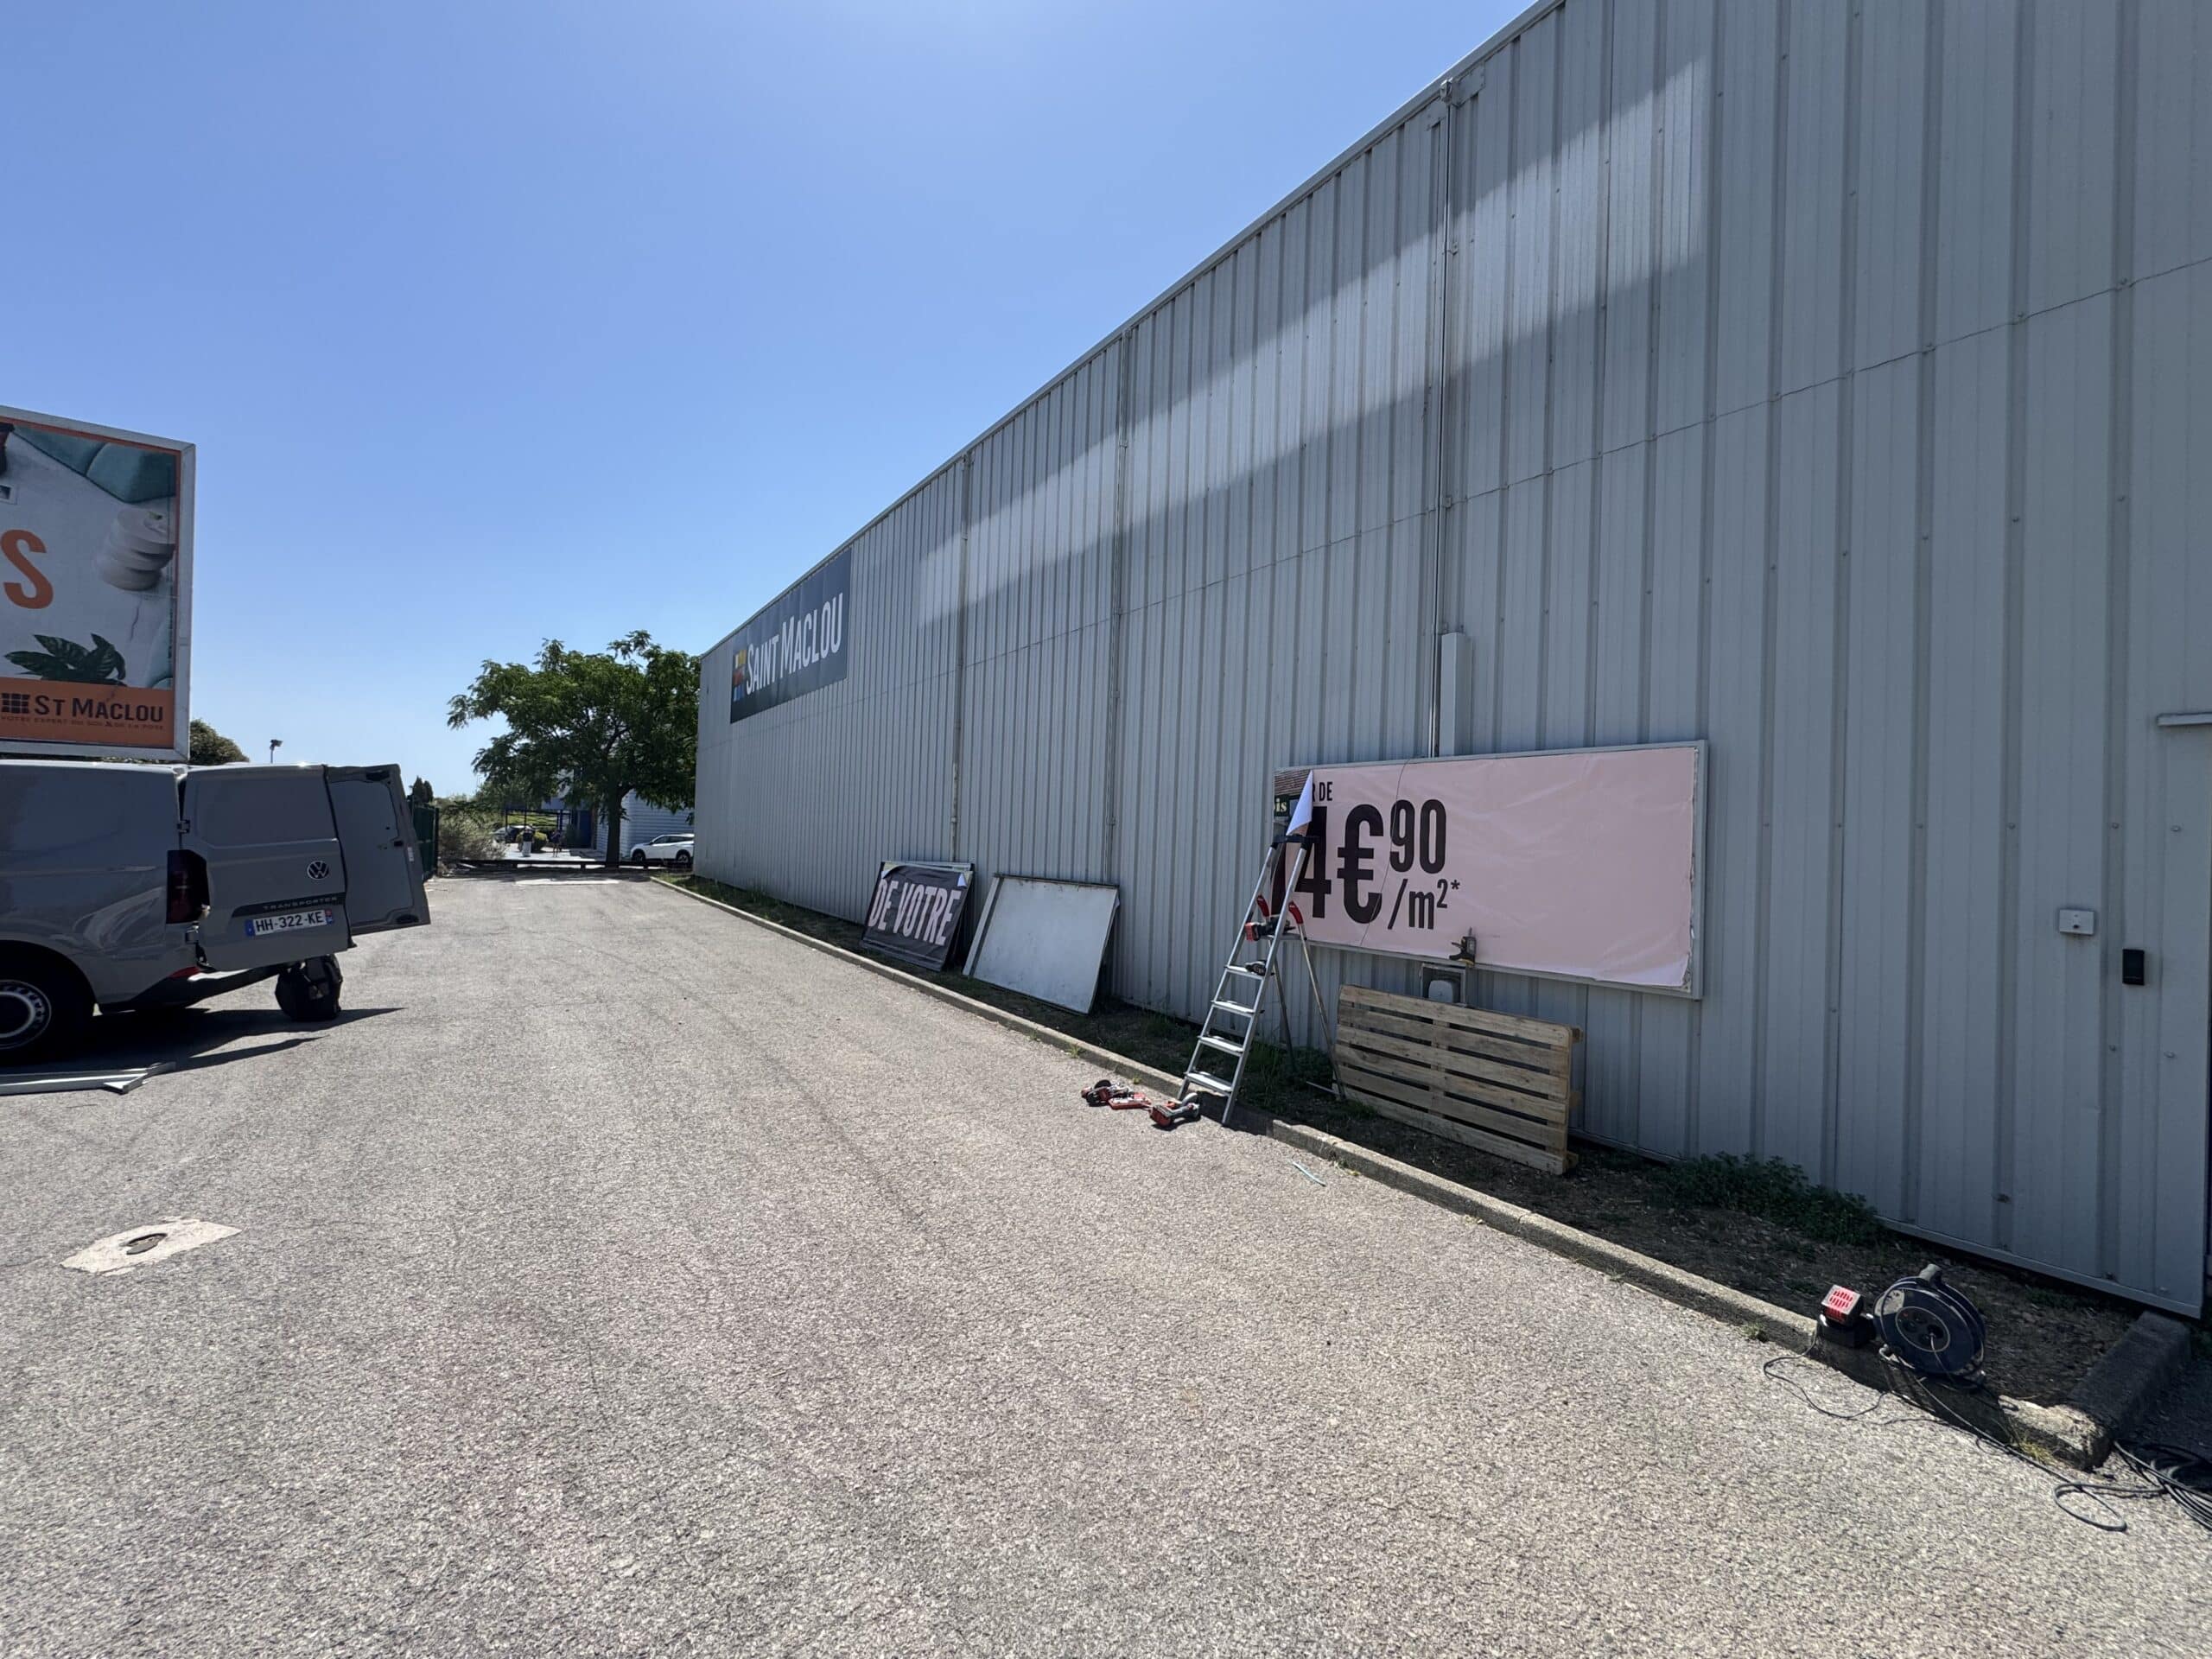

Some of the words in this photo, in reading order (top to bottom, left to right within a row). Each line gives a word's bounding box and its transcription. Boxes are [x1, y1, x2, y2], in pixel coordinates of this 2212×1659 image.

[1, 529, 54, 609] S
[747, 634, 779, 695] SAINT
[779, 592, 843, 678] MACLOU
[72, 697, 163, 722] MACLOU
[1319, 781, 1333, 802] DE
[1273, 798, 1287, 812] is
[255, 911, 324, 933] HH-322-KE
[868, 878, 899, 931] DE
[893, 882, 962, 946] VOTRE
